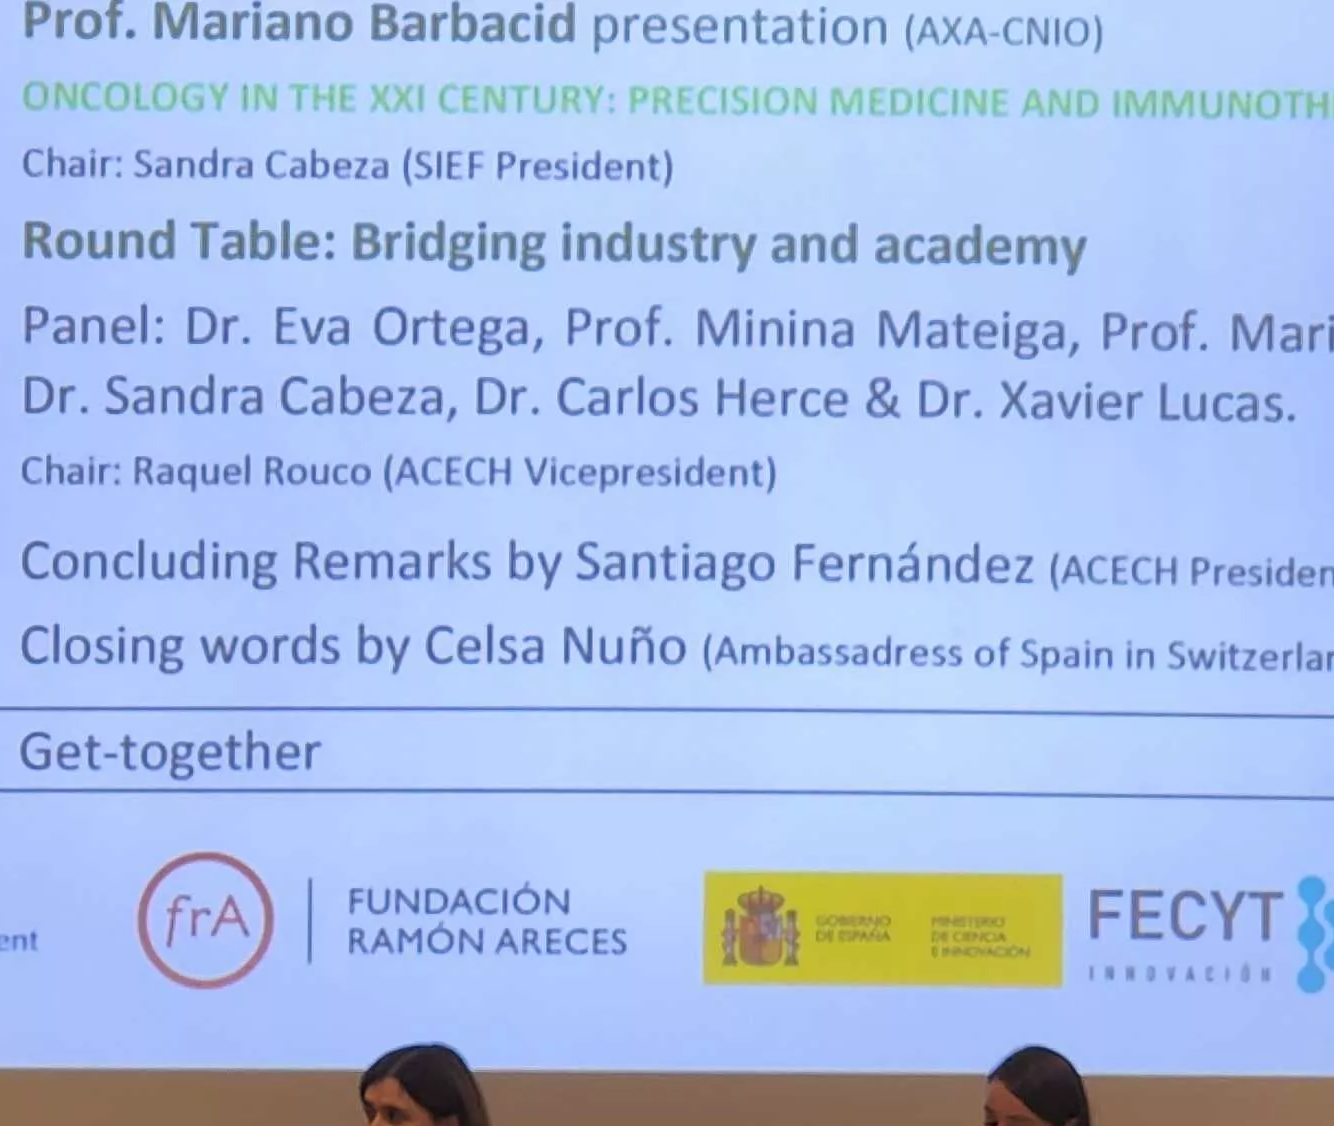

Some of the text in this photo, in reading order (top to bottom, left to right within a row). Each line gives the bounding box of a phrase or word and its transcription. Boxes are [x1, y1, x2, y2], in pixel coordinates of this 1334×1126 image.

[23, 0, 1103, 55] Prof. Mariano Barbacid presentation (AXA-CNIO)
[21, 80, 228, 112] ONCOLOGY
[240, 83, 278, 112] IN
[289, 83, 355, 112] THE
[369, 84, 424, 113] XXI
[437, 83, 615, 114] CENTURY:
[628, 85, 818, 116] PRECISION
[829, 86, 1006, 117] MEDICINE
[1021, 88, 1100, 118] AND
[21, 146, 673, 189] Chair: Sandra Cabeza (SIEF President)
[22, 218, 1088, 277] Round Table: Bridging industry and academy
[23, 303, 164, 345] Panel:
[185, 306, 251, 345] Dr.
[274, 306, 350, 347] Eva
[372, 305, 544, 357] Ortega,
[566, 304, 672, 347] Prof.
[696, 307, 854, 349] Minina
[877, 309, 1080, 361] Mateiga,
[1101, 308, 1208, 352] Prof.
[23, 373, 1296, 424] Dr. Sandra Cabeza, Dr. Carlos Herce & Dr. Xavier Lucas.
[20, 453, 777, 495] Chair: Raquel Rouco (ACECH Vicepresident)
[20, 538, 278, 591] Concluding
[293, 538, 492, 581] Remarks
[507, 538, 563, 591] by
[575, 540, 776, 592] Santiago
[793, 541, 1034, 585] Fernández
[1049, 552, 1178, 592] (ACECH
[20, 623, 184, 675] Closing
[198, 623, 341, 665] words
[356, 622, 411, 675] by
[424, 623, 544, 665] Celsa
[562, 625, 687, 666] Nuño
[702, 633, 964, 673] (Ambassadress
[973, 636, 1011, 668] of
[1019, 638, 1114, 676] Spain
[1125, 640, 1155, 670] in
[18, 728, 323, 782] Get-together
[347, 880, 571, 917] FUNDACIÓN
[1089, 888, 1285, 942] FECYT
[348, 921, 629, 956] RAMÓN ARECES
[1088, 962, 1273, 983] INNOVACIÓN
